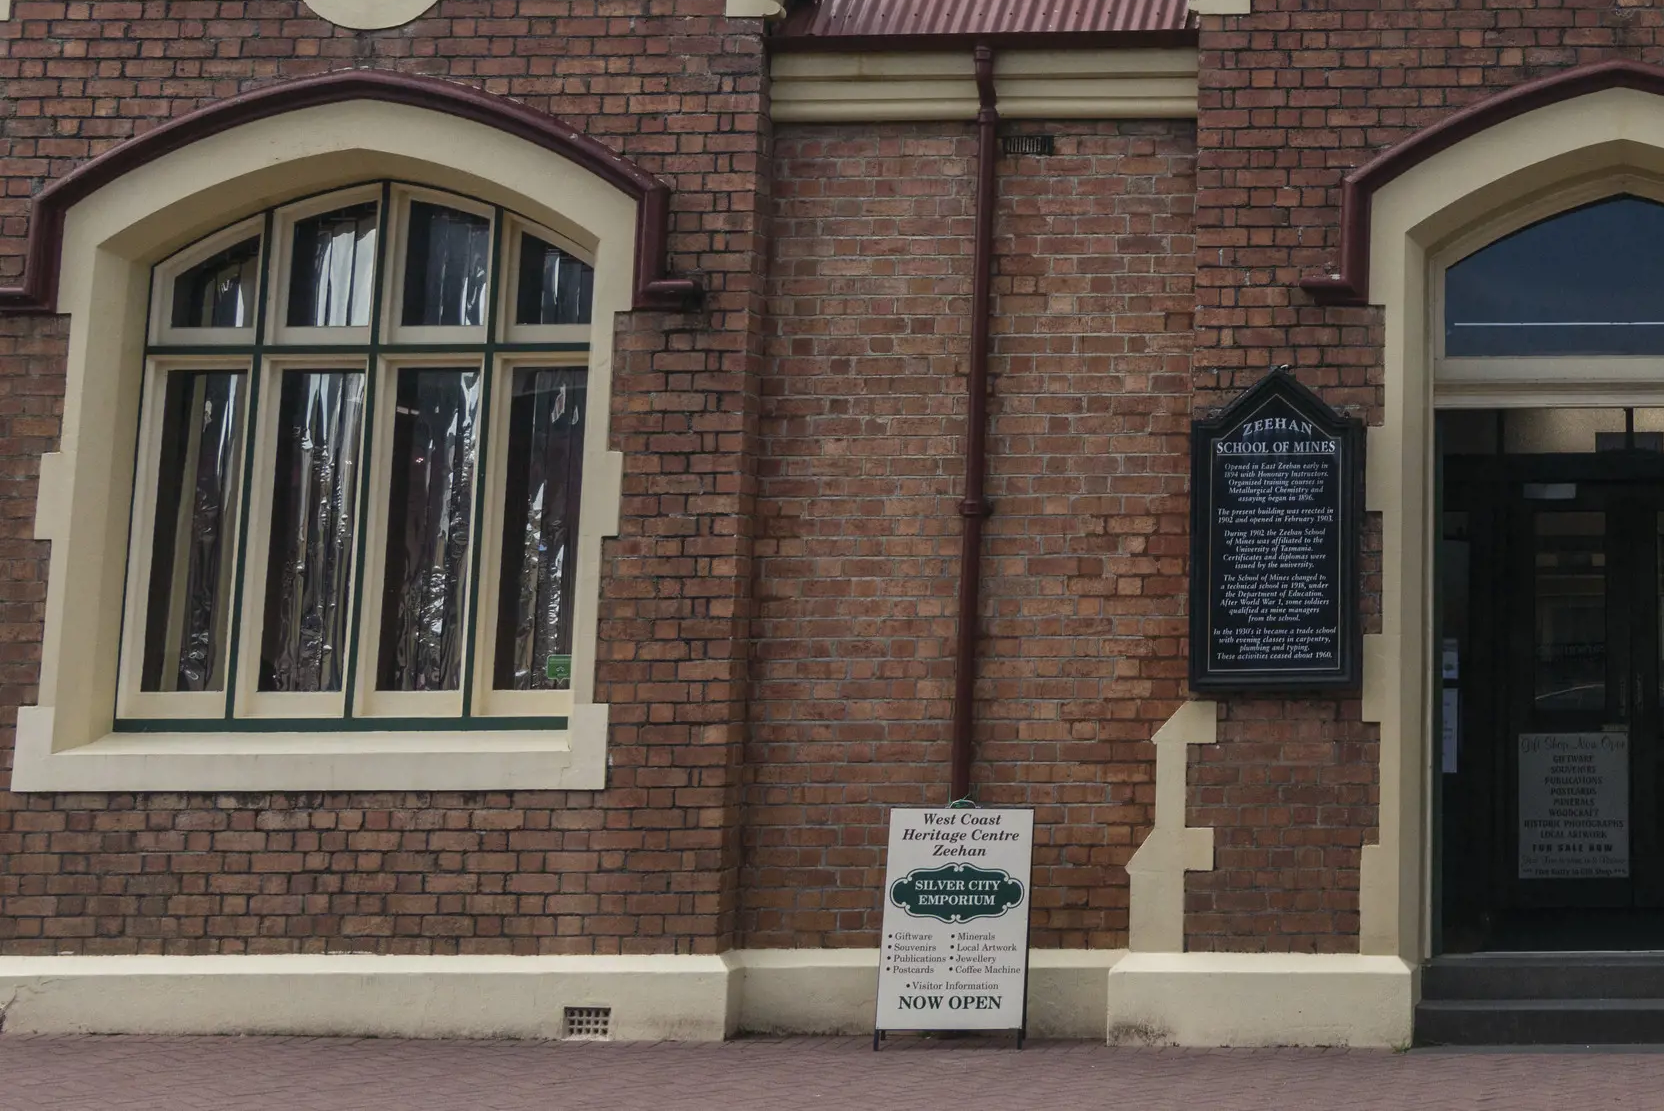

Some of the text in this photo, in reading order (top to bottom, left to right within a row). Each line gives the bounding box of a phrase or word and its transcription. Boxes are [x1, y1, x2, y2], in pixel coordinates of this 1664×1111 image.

[1243, 418, 1312, 436] ZEEHAN
[1216, 441, 1335, 453] SCHOOL OF MINES
[1224, 461, 1328, 472] Opened in East Zeehan early in
[1225, 469, 1329, 479] 1894 with Honorary Instructors.
[1228, 477, 1323, 488] Organised training courses in
[1229, 485, 1323, 495] Metallurgical Chemistry and
[1237, 493, 1313, 504] assaying began in 1896.
[1217, 651, 1333, 660] These activities ceased about 1960.
[924, 813, 1000, 825] West Coast
[902, 829, 1019, 843] Heritage Centre
[932, 845, 987, 856] Zeehan
[914, 880, 1001, 891] SILVER CITY
[918, 895, 996, 905] EMPORIUM
[894, 931, 933, 941] Giftware
[957, 931, 996, 941] Minerals
[893, 942, 937, 952] Souvenirs
[956, 942, 1017, 952] Local Artwork
[893, 954, 947, 963] Publications
[955, 954, 997, 964] Jewellery
[892, 964, 935, 974] Postcards
[955, 965, 1021, 974] Coffee Machine
[912, 980, 999, 990] Visitor Information
[898, 996, 1002, 1009] NOW OPEN
